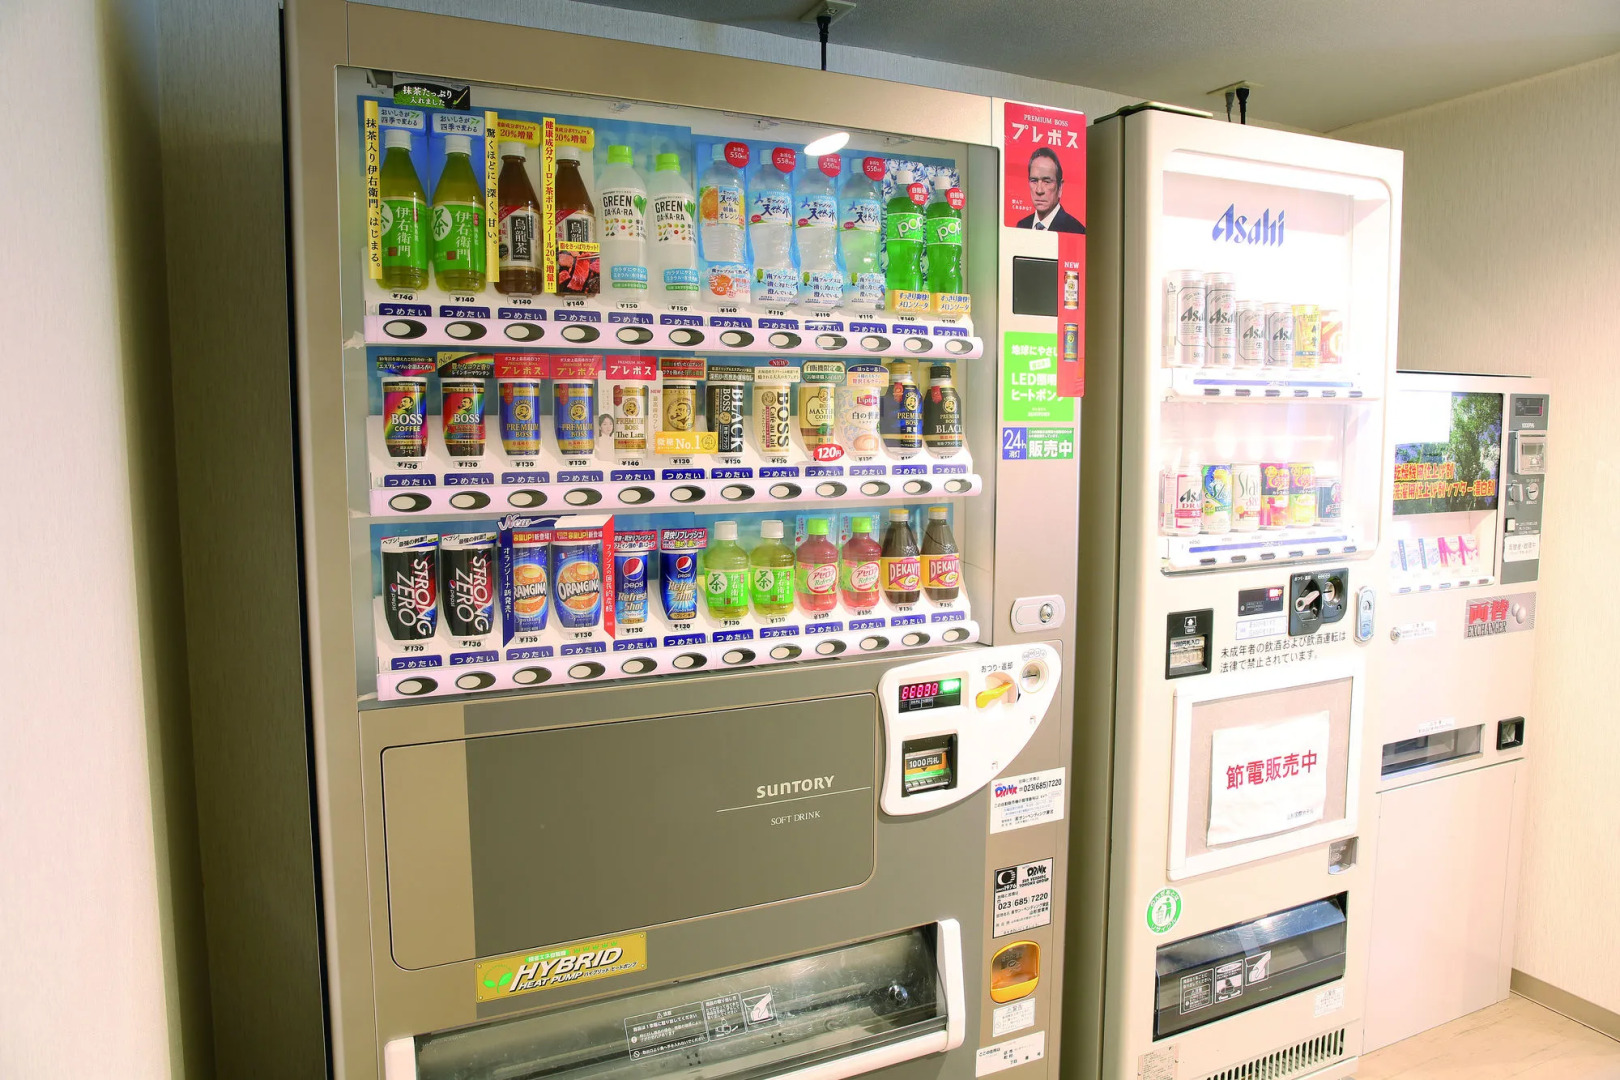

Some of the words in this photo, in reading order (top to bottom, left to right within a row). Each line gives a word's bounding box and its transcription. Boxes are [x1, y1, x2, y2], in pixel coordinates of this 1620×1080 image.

[403, 85, 453, 99] 抹茶たっぷり
[410, 96, 445, 106] 入れました
[381, 108, 410, 117] おいしさが
[380, 116, 418, 126] 四季で変わる
[440, 115, 470, 124] おいしさが
[1023, 114, 1052, 125] PREMIUM
[1054, 119, 1069, 127] BOSS
[440, 123, 478, 132] 四季で変わる
[500, 129, 534, 140] 20%増量
[1011, 122, 1079, 149] プレボス
[603, 194, 632, 208] GREEN
[655, 200, 683, 214] GREEN
[433, 208, 449, 237] 茶
[897, 216, 923, 237] pop
[1212, 203, 1285, 248] Asahi
[395, 206, 411, 258] 伊右衛門
[455, 210, 472, 260] 伊右衛門
[936, 221, 962, 242] pop
[1064, 261, 1079, 269] NEW
[384, 308, 427, 316] つめたい
[445, 310, 486, 318] つめたい
[559, 313, 598, 321] つめたい
[714, 320, 749, 328] つめたい
[763, 321, 796, 329] つめたい
[853, 325, 883, 333] つめたい
[1195, 325, 1203, 333] 生
[1224, 327, 1232, 335] 生
[1011, 344, 1057, 357] 地球にやさし
[610, 365, 652, 376] プレボス
[722, 388, 731, 412] BOSS
[391, 413, 423, 425] BOSS
[453, 413, 480, 423] BOSS
[730, 388, 744, 452] BLACK
[776, 391, 790, 448] BOSS
[506, 423, 539, 431] PREMIUM
[562, 423, 594, 431] PREMIUM
[676, 435, 700, 450] No.1
[1004, 429, 1027, 450] 24h
[817, 446, 842, 459] 120円
[1028, 440, 1073, 458] 販売中
[561, 474, 599, 482] つめたい
[615, 473, 651, 481] つめたい
[715, 470, 749, 478] つめたい
[763, 469, 796, 477] つめたい
[853, 468, 883, 476] つめたい
[389, 478, 432, 486] つめたい
[449, 476, 490, 485] つめたい
[663, 530, 704, 540] 爽快リフレッシュ!
[503, 547, 512, 620] オランジーナ新発売!
[709, 574, 725, 592] 茶
[756, 570, 772, 589] 茶
[777, 570, 785, 601] 伊右衛門
[455, 568, 475, 622] ZERO
[472, 556, 489, 631] STRONG
[558, 579, 600, 602] ORANGINA
[730, 574, 739, 604] 伊右衛門
[396, 571, 417, 626] ZERO
[413, 558, 432, 636] STRONG
[618, 592, 647, 601] Refresh
[674, 591, 693, 601] Shot
[624, 602, 643, 611] Shot
[1469, 600, 1509, 625] 両替
[852, 621, 882, 630] つめたい
[1467, 621, 1507, 638] EXCHANGER
[717, 633, 750, 641] つめたい
[764, 628, 797, 637] つめたい
[566, 646, 602, 654] つめたい
[617, 641, 653, 650] つめたい
[1220, 630, 1347, 658] 未成年者の飲酒および飲酒運転は
[396, 660, 437, 669] つめたい
[455, 655, 494, 664] つめたい
[1220, 650, 1318, 674] 法律で禁止されています。
[981, 662, 1013, 673] おつり・返却
[909, 755, 940, 768] 1000円札
[1226, 749, 1318, 791] 節電販売中
[756, 775, 835, 799] SUNTORY
[1023, 778, 1062, 793] 023(685)7220
[770, 815, 792, 826] SOFT
[794, 810, 821, 822] DRINK
[509, 947, 623, 992] HYBRID
[518, 978, 550, 990] HEAT
[550, 971, 583, 984] PUMP
